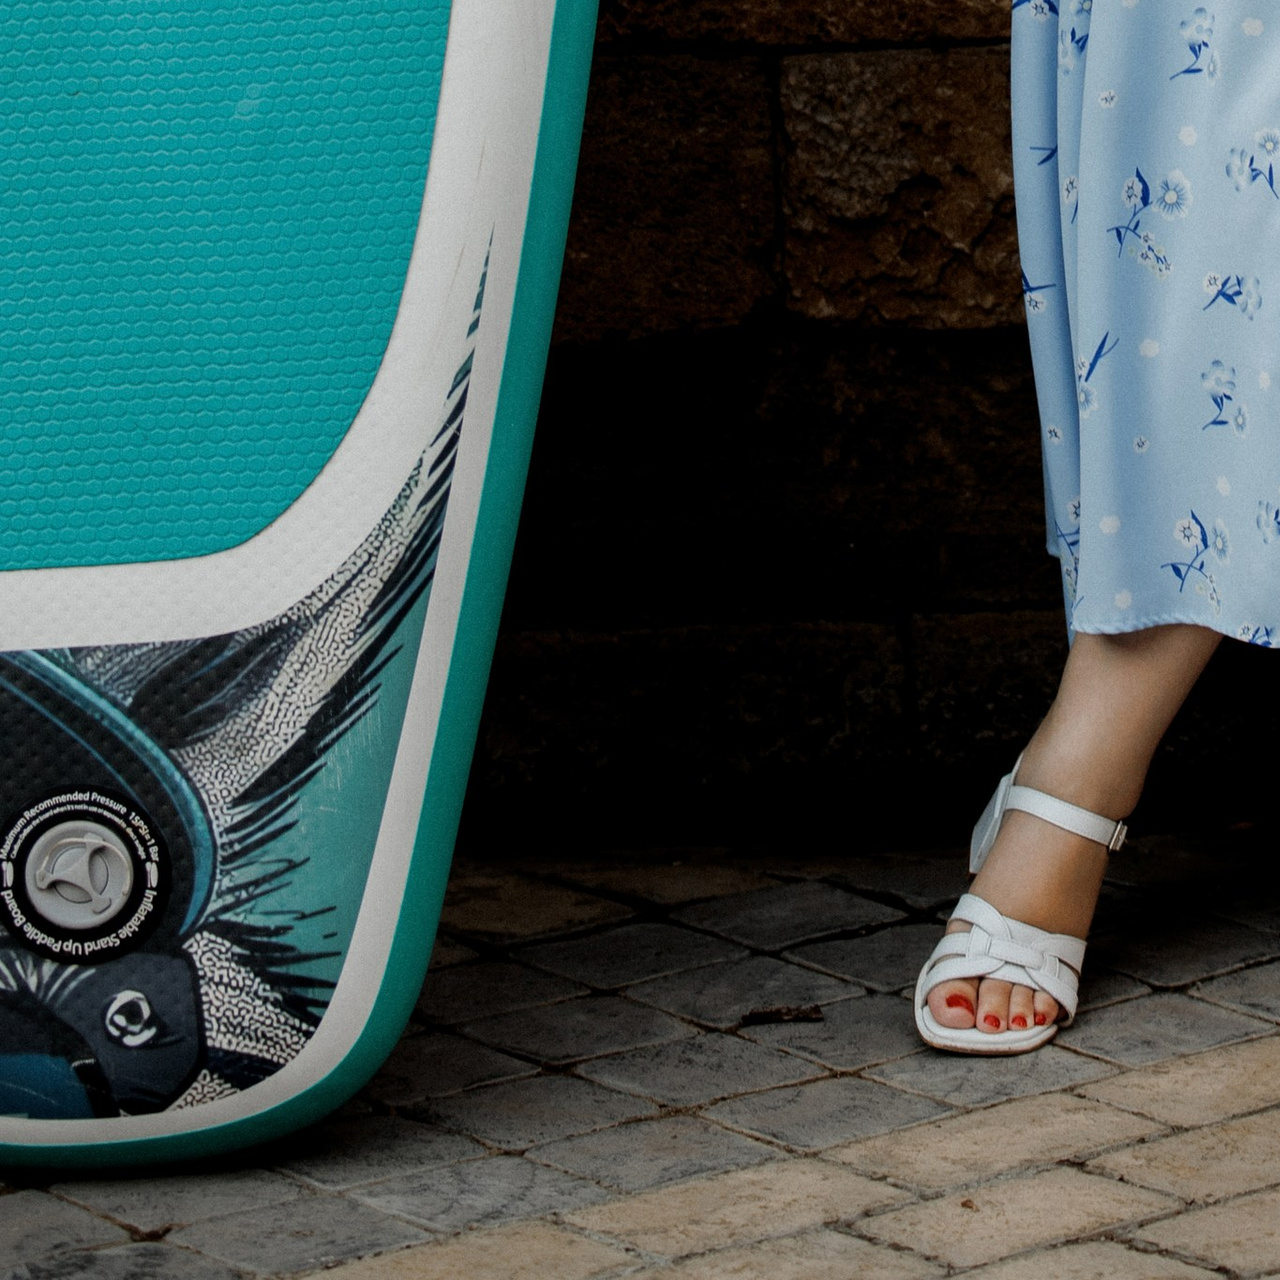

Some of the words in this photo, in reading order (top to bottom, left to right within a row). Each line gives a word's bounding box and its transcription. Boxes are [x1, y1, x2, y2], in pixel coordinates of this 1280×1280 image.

[0, 817, 27, 859] Maximum
[23, 790, 90, 820] Recommended
[91, 792, 127, 814] Pressure
[149, 845, 159, 862] Bar
[0, 889, 26, 927] Board
[117, 889, 157, 939] Inflatable
[23, 922, 62, 952] Paddle
[62, 939, 82, 955] Up
[84, 933, 120, 956] Stand
